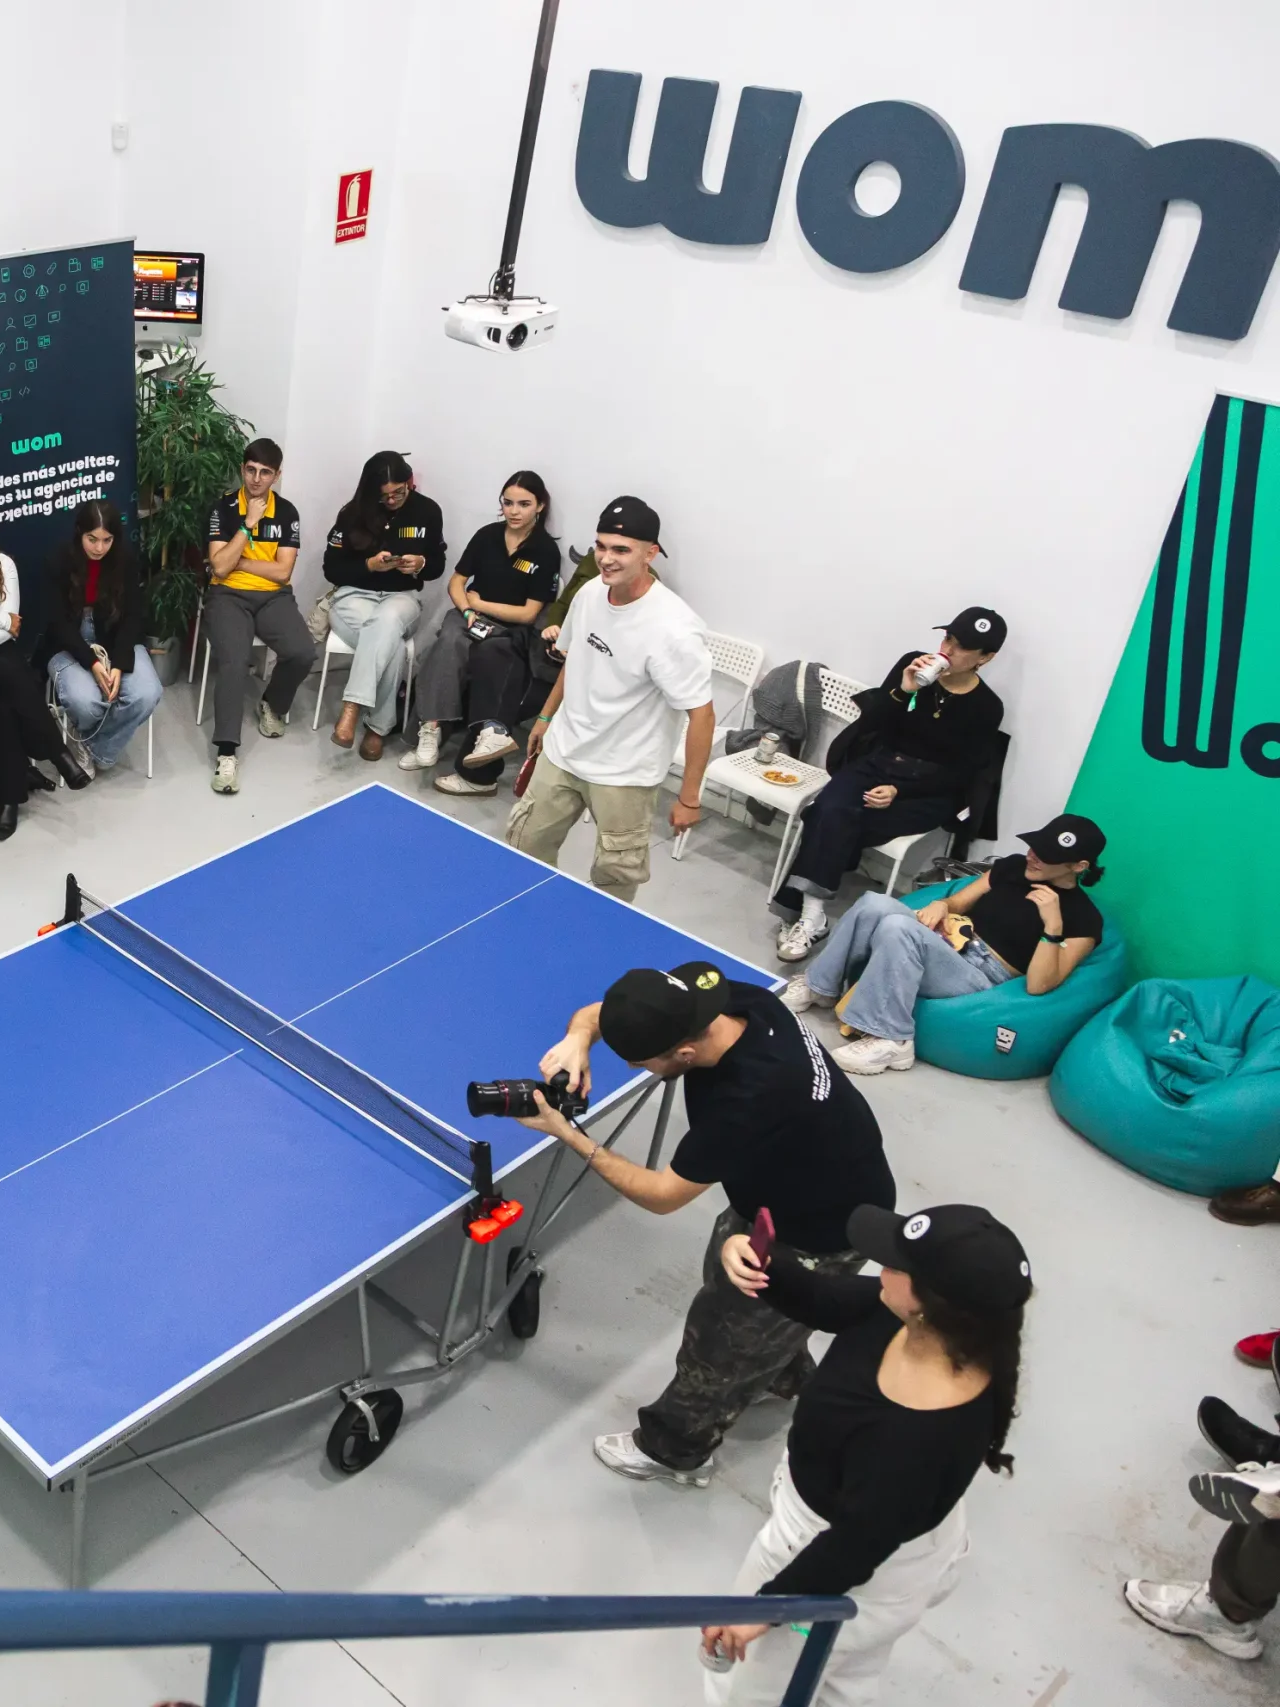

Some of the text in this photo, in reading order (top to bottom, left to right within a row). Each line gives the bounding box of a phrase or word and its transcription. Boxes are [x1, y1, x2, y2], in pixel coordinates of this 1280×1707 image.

[575, 69, 1280, 342] wom
[337, 224, 365, 238] EXTINTOR
[11, 432, 62, 455] wom
[22, 464, 56, 483] más
[57, 454, 120, 475] vueltas,
[33, 472, 93, 500] agencia
[94, 470, 115, 484] de
